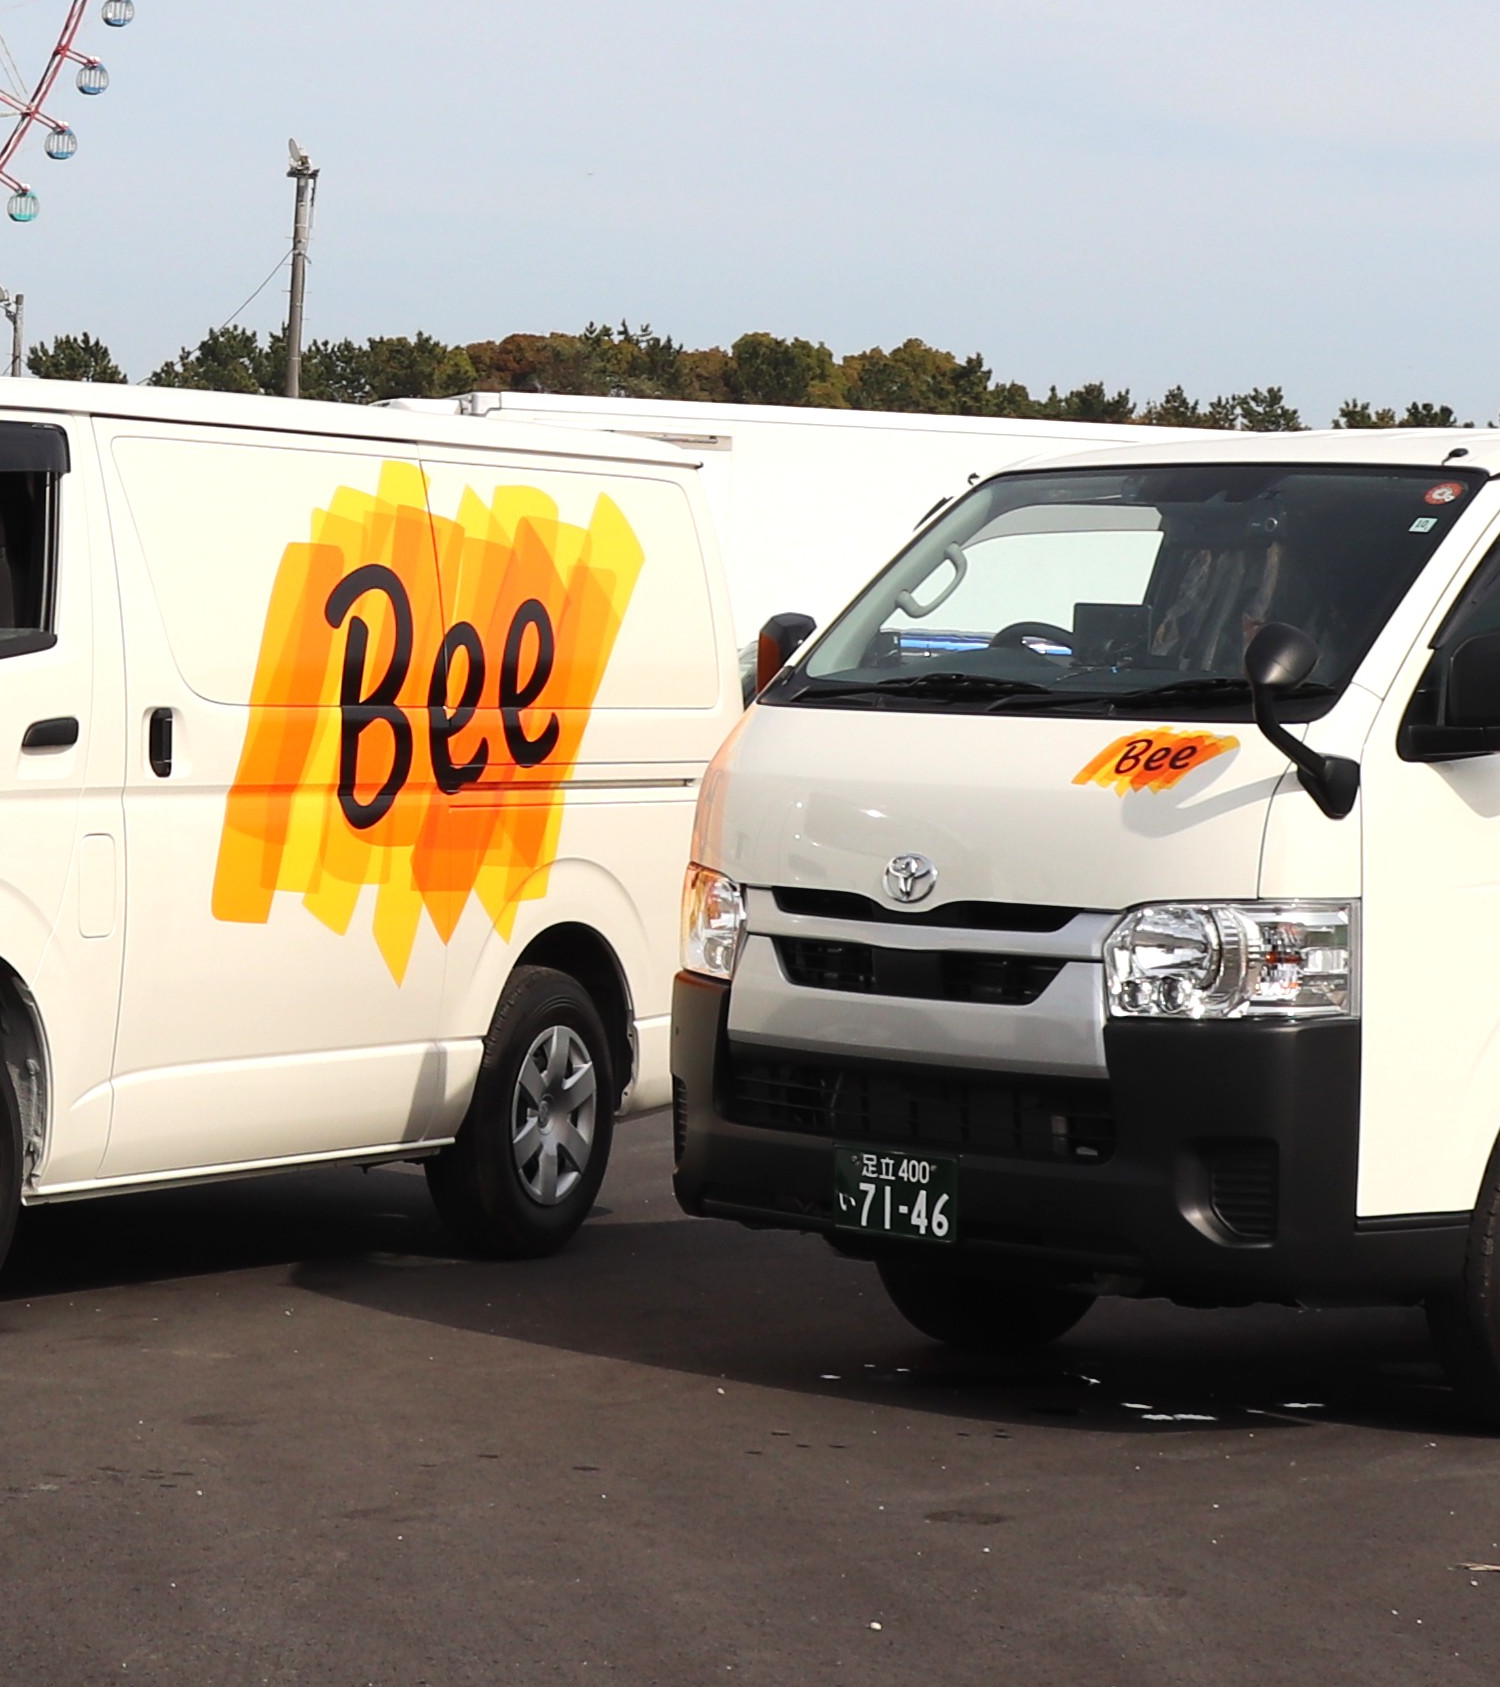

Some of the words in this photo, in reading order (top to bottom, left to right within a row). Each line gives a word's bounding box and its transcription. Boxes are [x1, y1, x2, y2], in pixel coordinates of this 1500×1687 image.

[325, 563, 560, 830] Bee
[1114, 738, 1198, 775] Bee
[839, 1192, 856, 1211] い
[859, 1182, 950, 1237] 71-46
